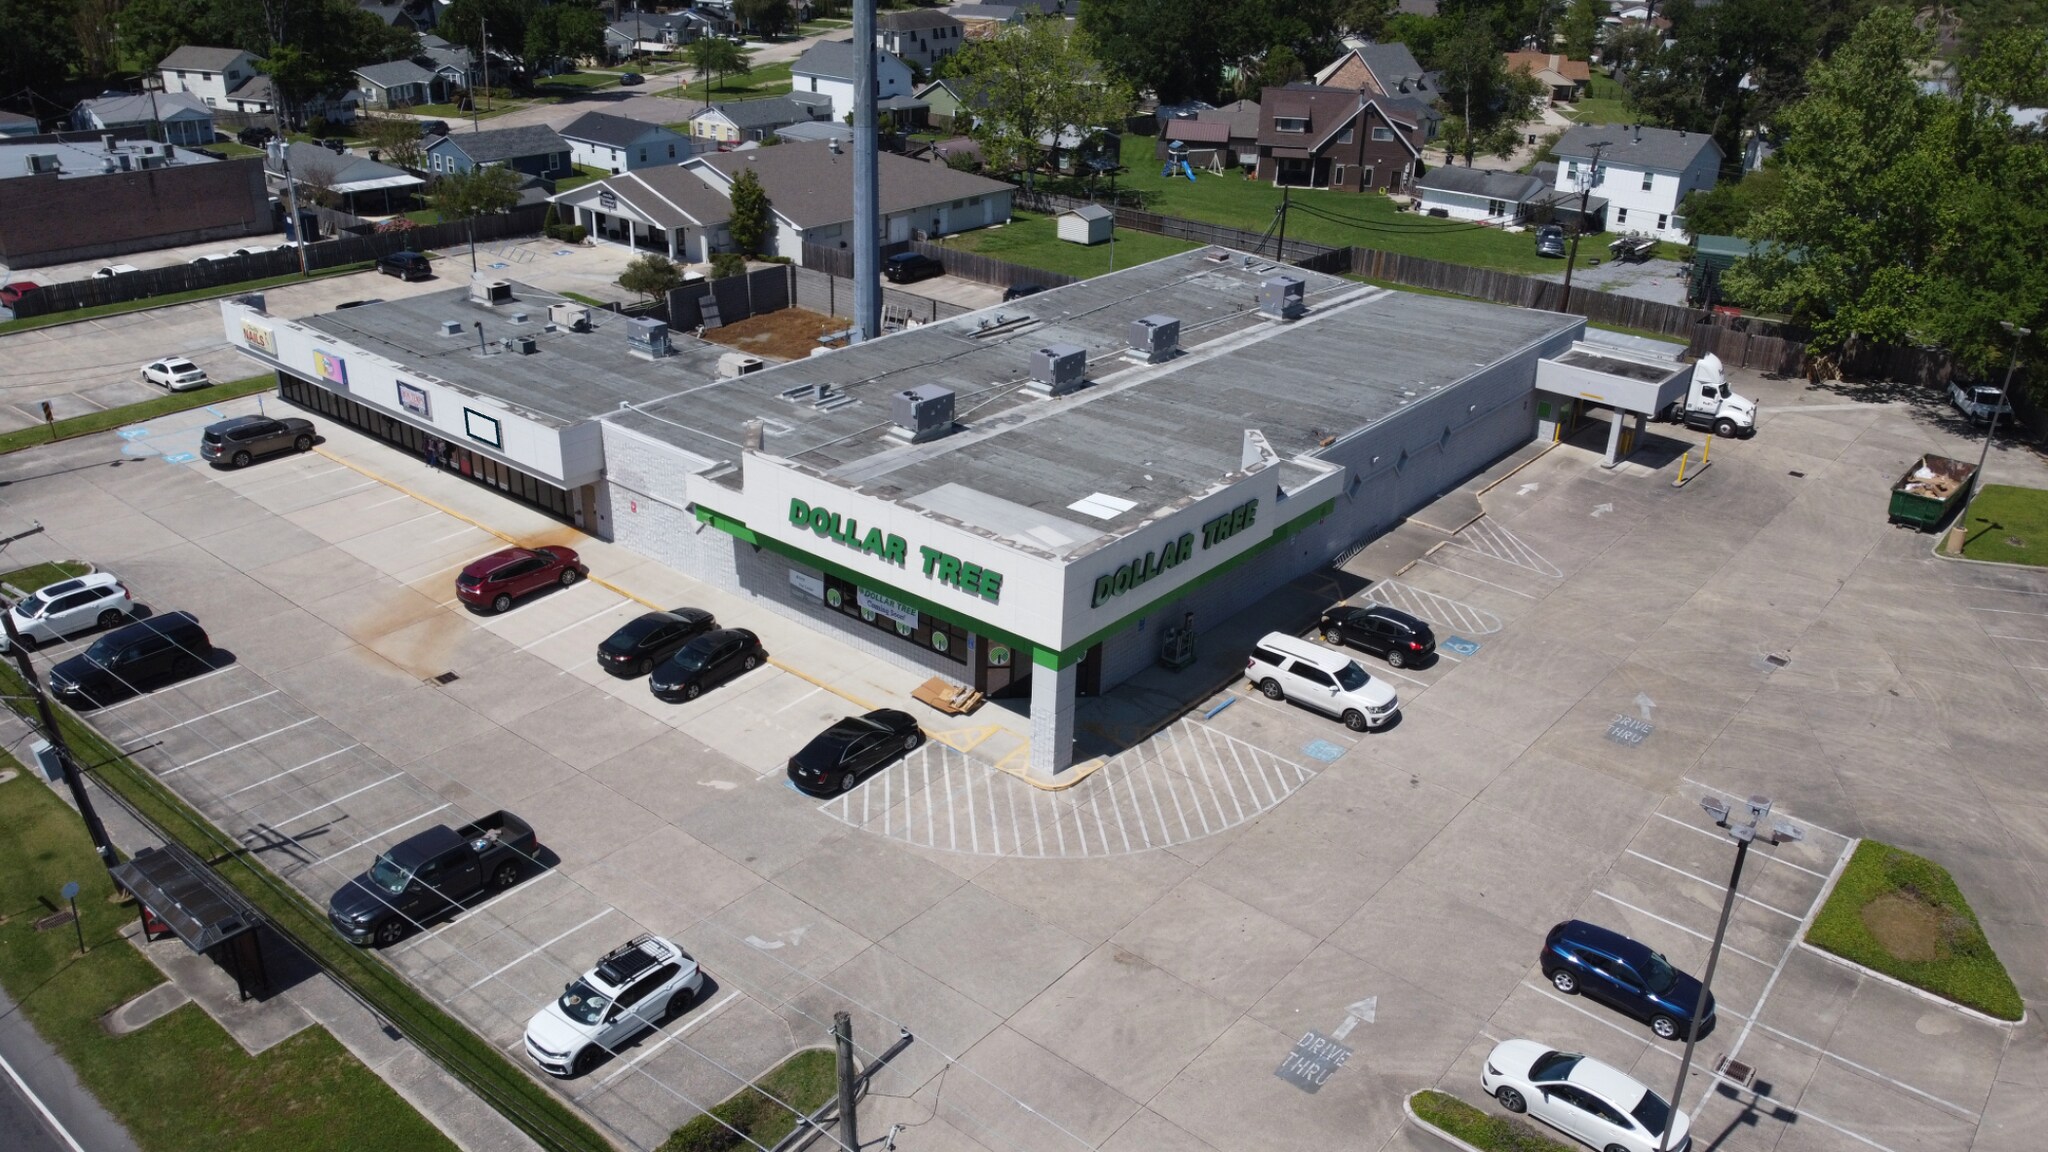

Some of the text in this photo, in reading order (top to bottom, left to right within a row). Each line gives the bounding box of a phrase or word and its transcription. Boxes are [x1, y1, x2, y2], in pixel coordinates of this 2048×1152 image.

[243, 328, 265, 346] NAILS
[789, 497, 1003, 601] DOLLAR TREE
[1091, 499, 1259, 608] DOLLAR TREE
[864, 590, 917, 616] DOLLAR TREE
[1607, 724, 1643, 743] THRU
[1612, 713, 1654, 733] DRIVE
[1297, 1031, 1353, 1067] DRIVE
[1282, 1051, 1333, 1086] THRU
